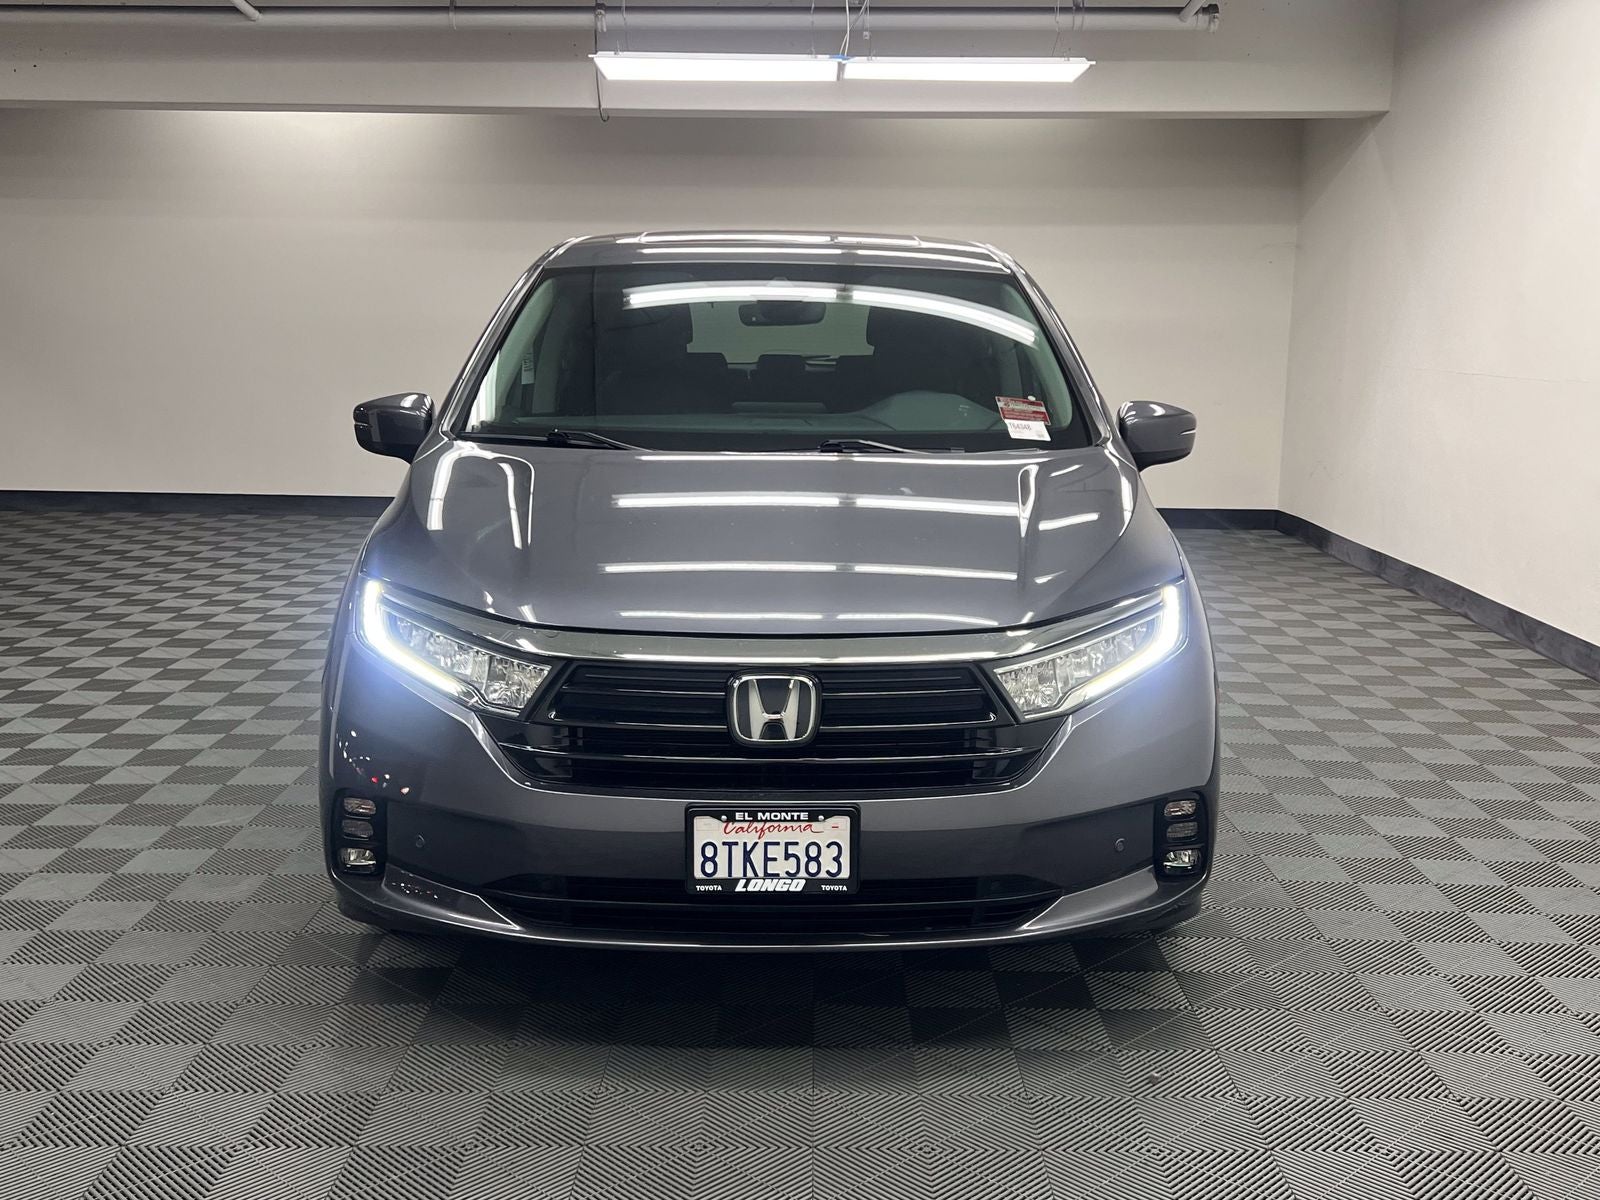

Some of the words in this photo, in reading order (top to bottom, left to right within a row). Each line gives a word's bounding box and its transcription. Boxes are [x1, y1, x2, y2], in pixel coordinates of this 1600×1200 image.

[735, 812, 753, 821] EL
[757, 812, 809, 821] MONTE
[723, 821, 825, 840] California
[700, 841, 843, 878] 8TKE583
[734, 879, 806, 892] LONGO
